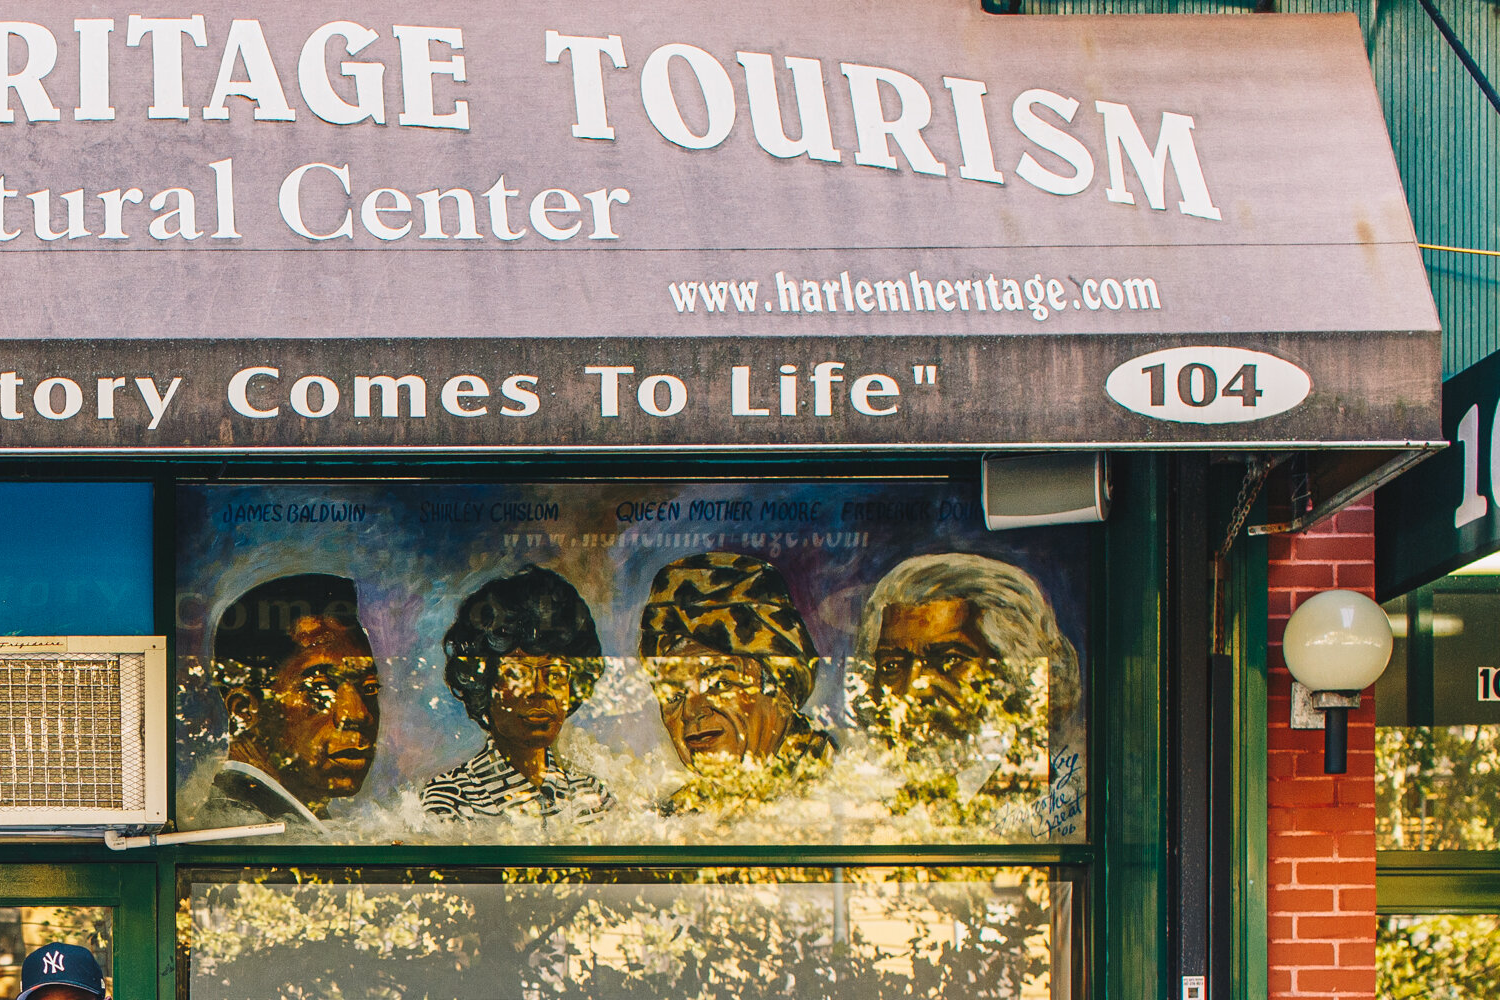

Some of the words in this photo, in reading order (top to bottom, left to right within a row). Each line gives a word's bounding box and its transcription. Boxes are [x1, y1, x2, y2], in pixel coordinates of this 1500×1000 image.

[545, 29, 1222, 221] TOURISM
[278, 162, 630, 241] Center
[668, 270, 1161, 321] www.harlemheritage.com
[227, 366, 540, 419] Comes
[584, 366, 688, 417] To
[731, 361, 937, 416] Life"
[1141, 362, 1263, 408] 104
[223, 502, 283, 523] JAMES
[286, 502, 367, 523] BALDWIN
[419, 502, 485, 523] SHIRLEY
[489, 501, 560, 523] CHISLOM
[615, 501, 681, 523] QUEEN
[688, 500, 754, 522] MOTHER
[760, 500, 820, 522] MOORE
[42, 950, 65, 975] NY
